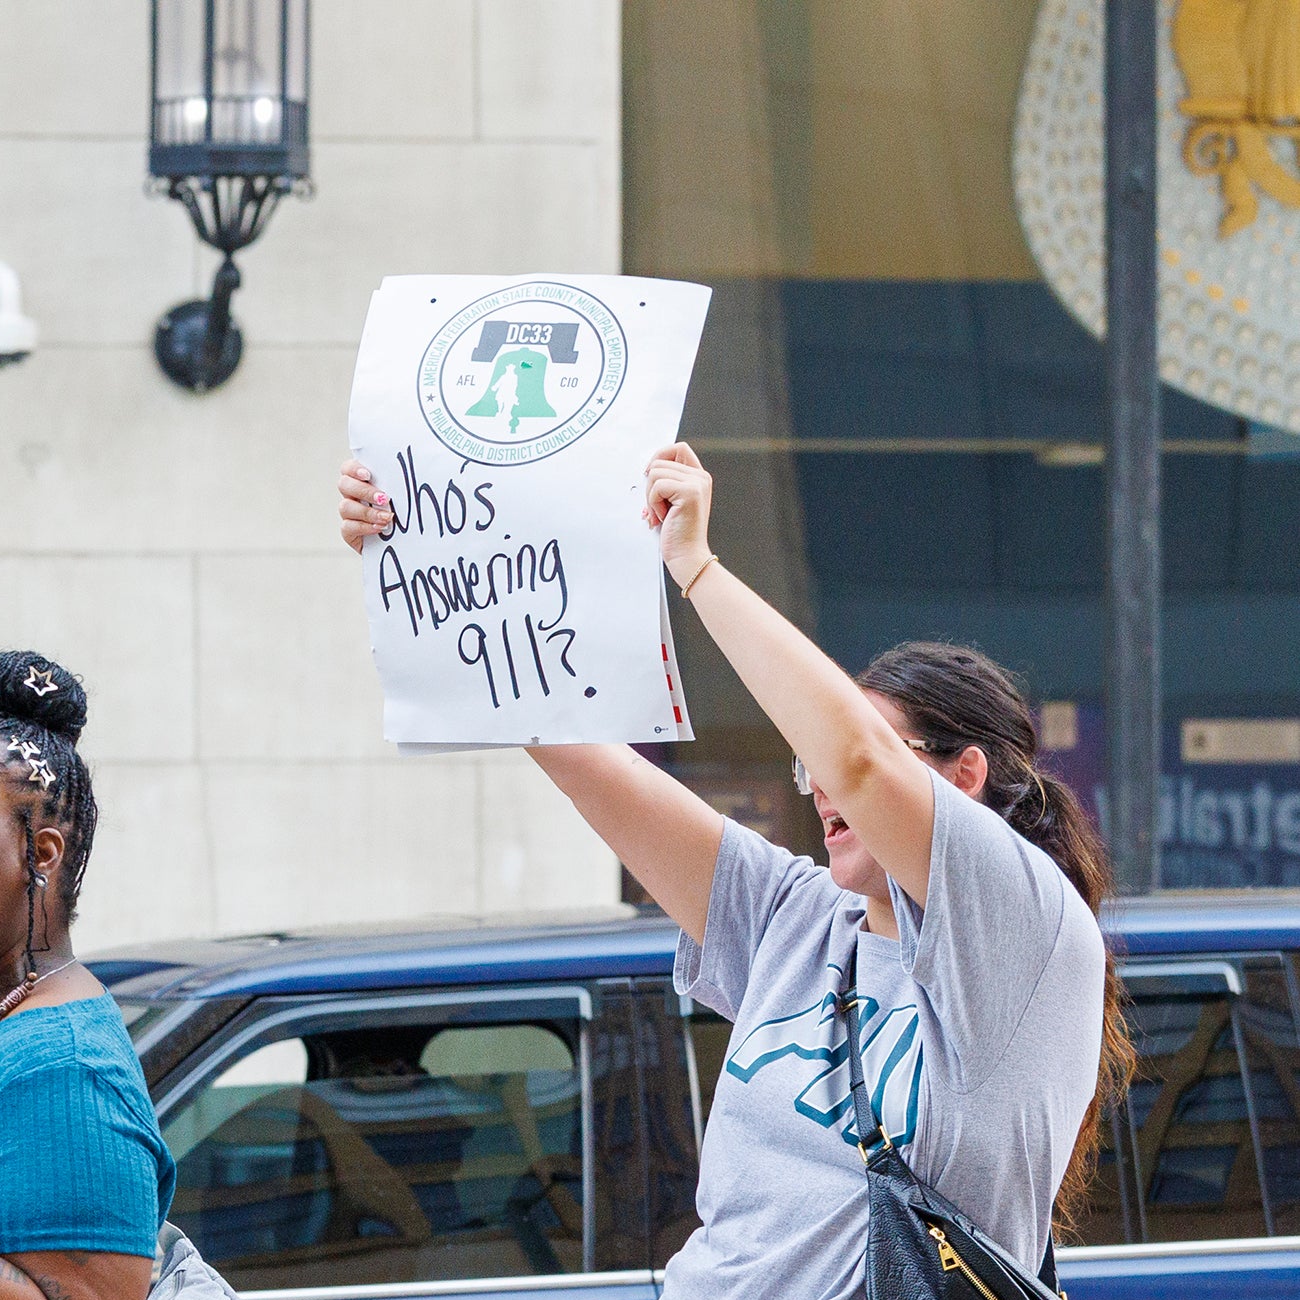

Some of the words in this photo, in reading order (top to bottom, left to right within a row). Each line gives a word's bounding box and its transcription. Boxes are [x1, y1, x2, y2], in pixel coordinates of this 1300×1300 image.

[423, 340, 448, 387] AMERICAN
[442, 297, 500, 340] FEDERATION
[502, 286, 532, 304] STATE
[535, 286, 579, 304] COUNTY
[575, 297, 616, 337] MUNICIPAL
[602, 336, 622, 392] EMPLOYEES
[505, 323, 553, 345] DC33
[456, 375, 476, 387] AFL
[559, 377, 579, 389] CIO
[429, 407, 484, 460] PHILADELPHIA
[486, 445, 533, 463] DISTRICT
[535, 423, 580, 455] COUNCIL
[576, 408, 597, 428] #33
[379, 534, 569, 637] Answering
[457, 613, 598, 709] 911?
